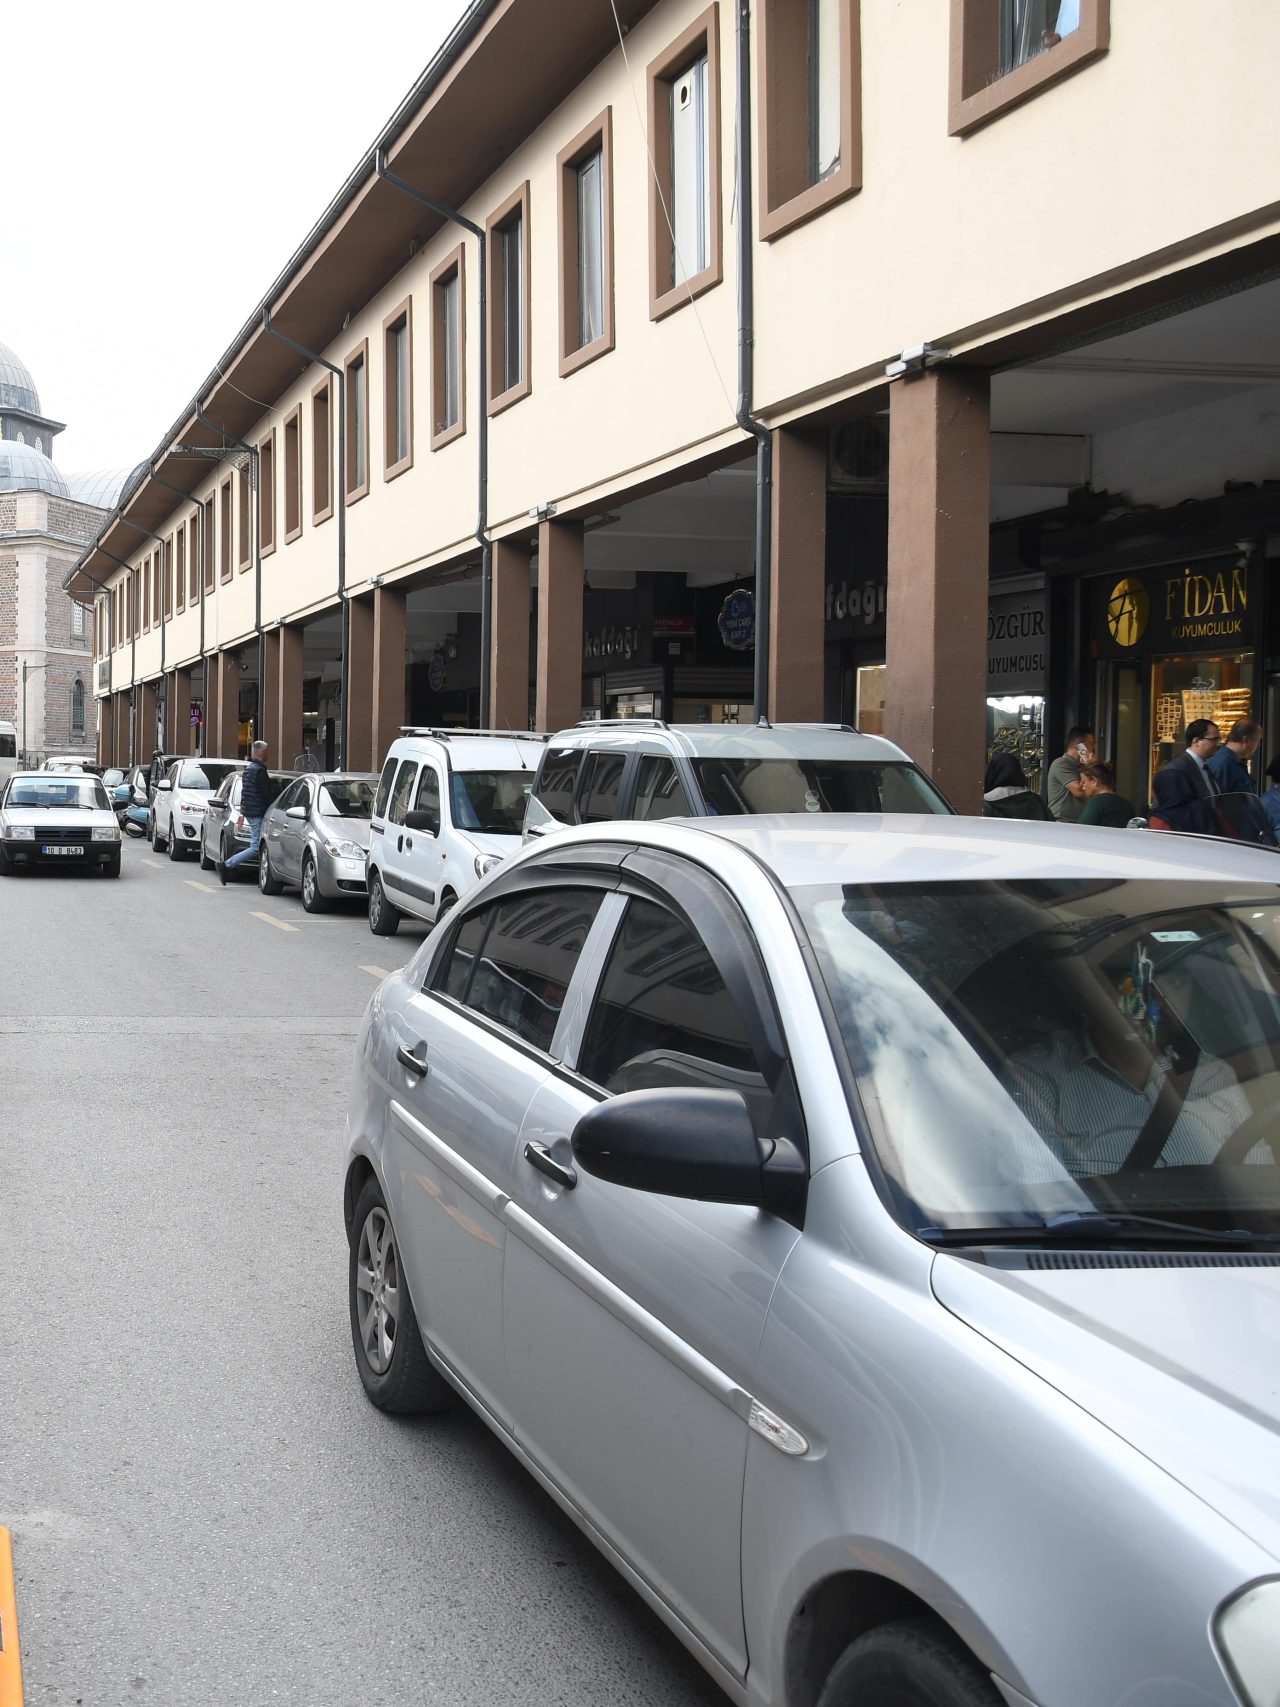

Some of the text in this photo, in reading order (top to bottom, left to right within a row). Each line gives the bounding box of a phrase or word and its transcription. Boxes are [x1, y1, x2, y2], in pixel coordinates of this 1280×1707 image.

[825, 580, 886, 625] fdağı
[1164, 567, 1248, 621] FİDAN
[585, 625, 639, 660] kafdağı
[1172, 621, 1243, 639] KUYUMCULUK
[988, 653, 1046, 674] UYUMCUSU
